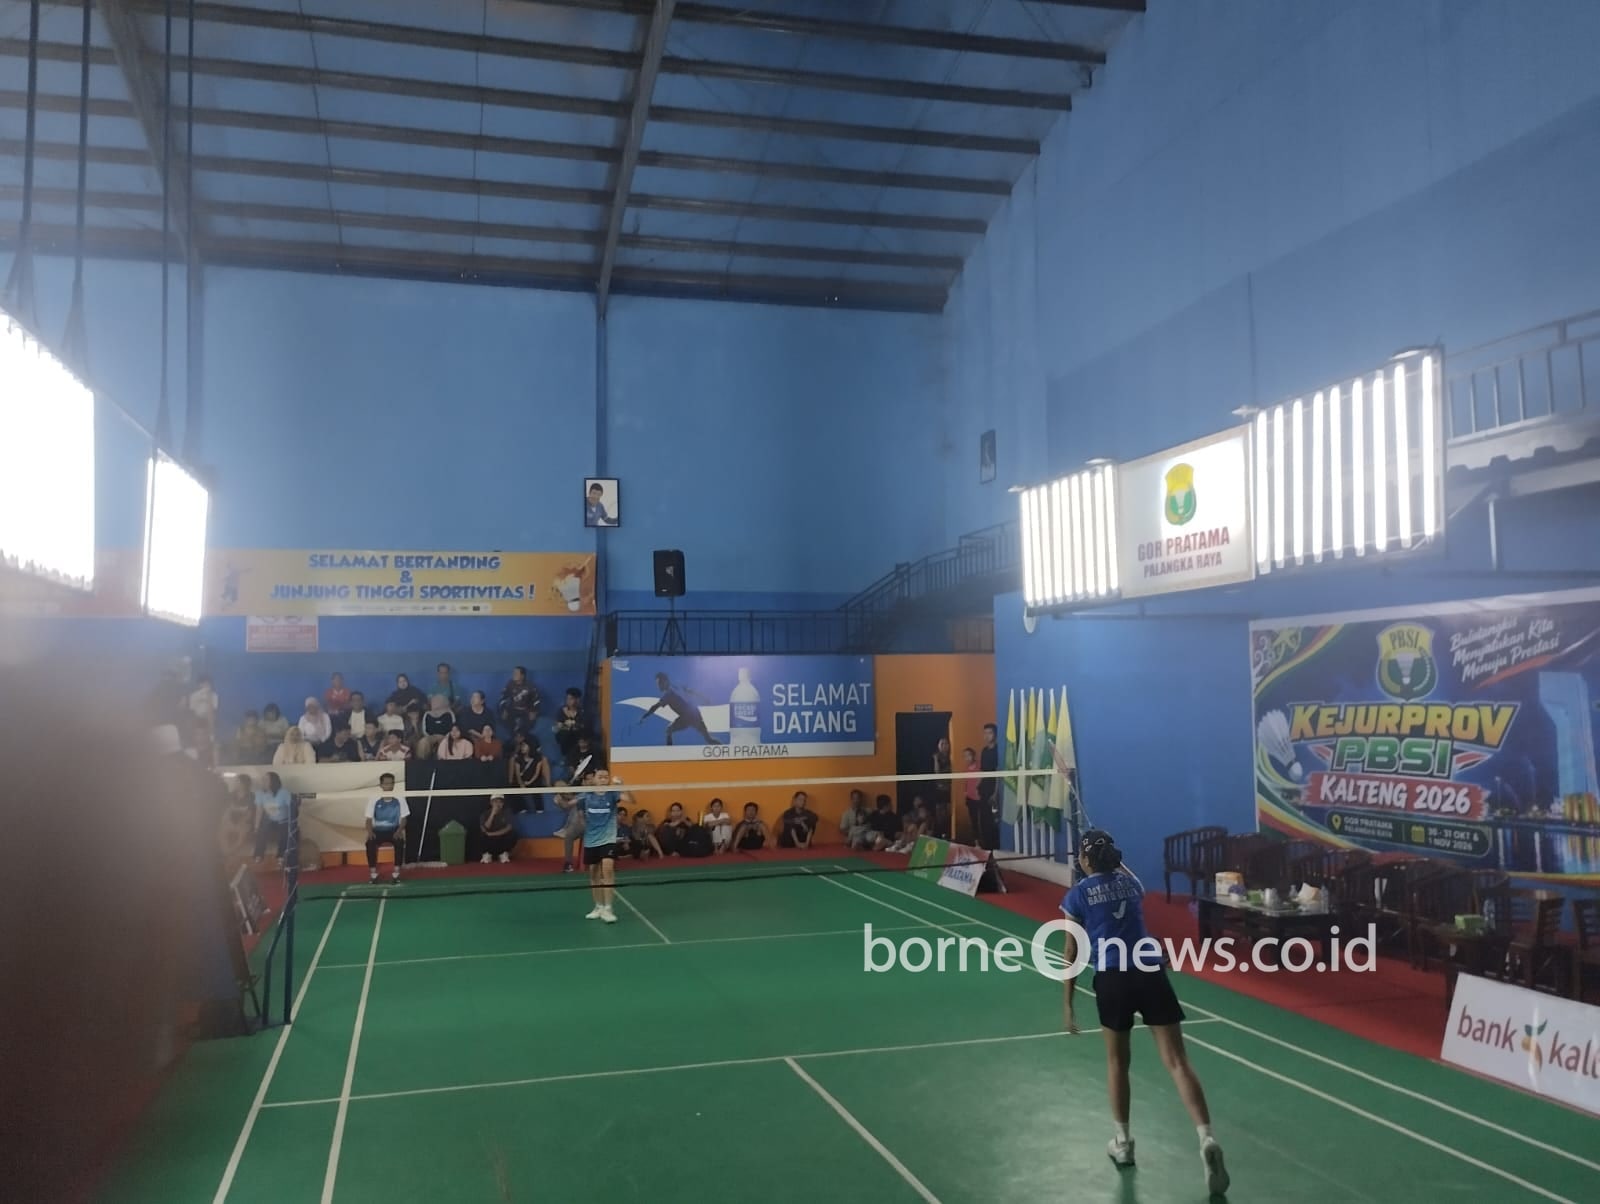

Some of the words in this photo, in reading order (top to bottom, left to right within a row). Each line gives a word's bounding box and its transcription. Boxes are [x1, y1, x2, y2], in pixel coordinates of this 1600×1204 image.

[1137, 541, 1162, 562] GOR
[1166, 526, 1230, 555] PRATAMA
[309, 554, 389, 568] SELAMAT
[394, 555, 500, 569] BERTANDING
[1143, 556, 1194, 579] PALANGKA
[1196, 551, 1223, 569] RAYA
[400, 570, 413, 583] &
[270, 585, 350, 599] JUNJUNG
[356, 585, 414, 599] TINGGI
[420, 585, 524, 600] SPORTIVITAS
[1389, 627, 1420, 650] PBSI
[772, 682, 871, 706] SELAMAT
[773, 711, 857, 734] DATANG
[1289, 703, 1516, 748] KEJURPROV
[703, 746, 730, 758] GOR
[734, 745, 789, 757] PRATAMA
[1332, 736, 1452, 778] PBSI
[1320, 774, 1408, 809] KALTENG
[1413, 785, 1471, 814] 2026
[1457, 1004, 1518, 1053] bank
